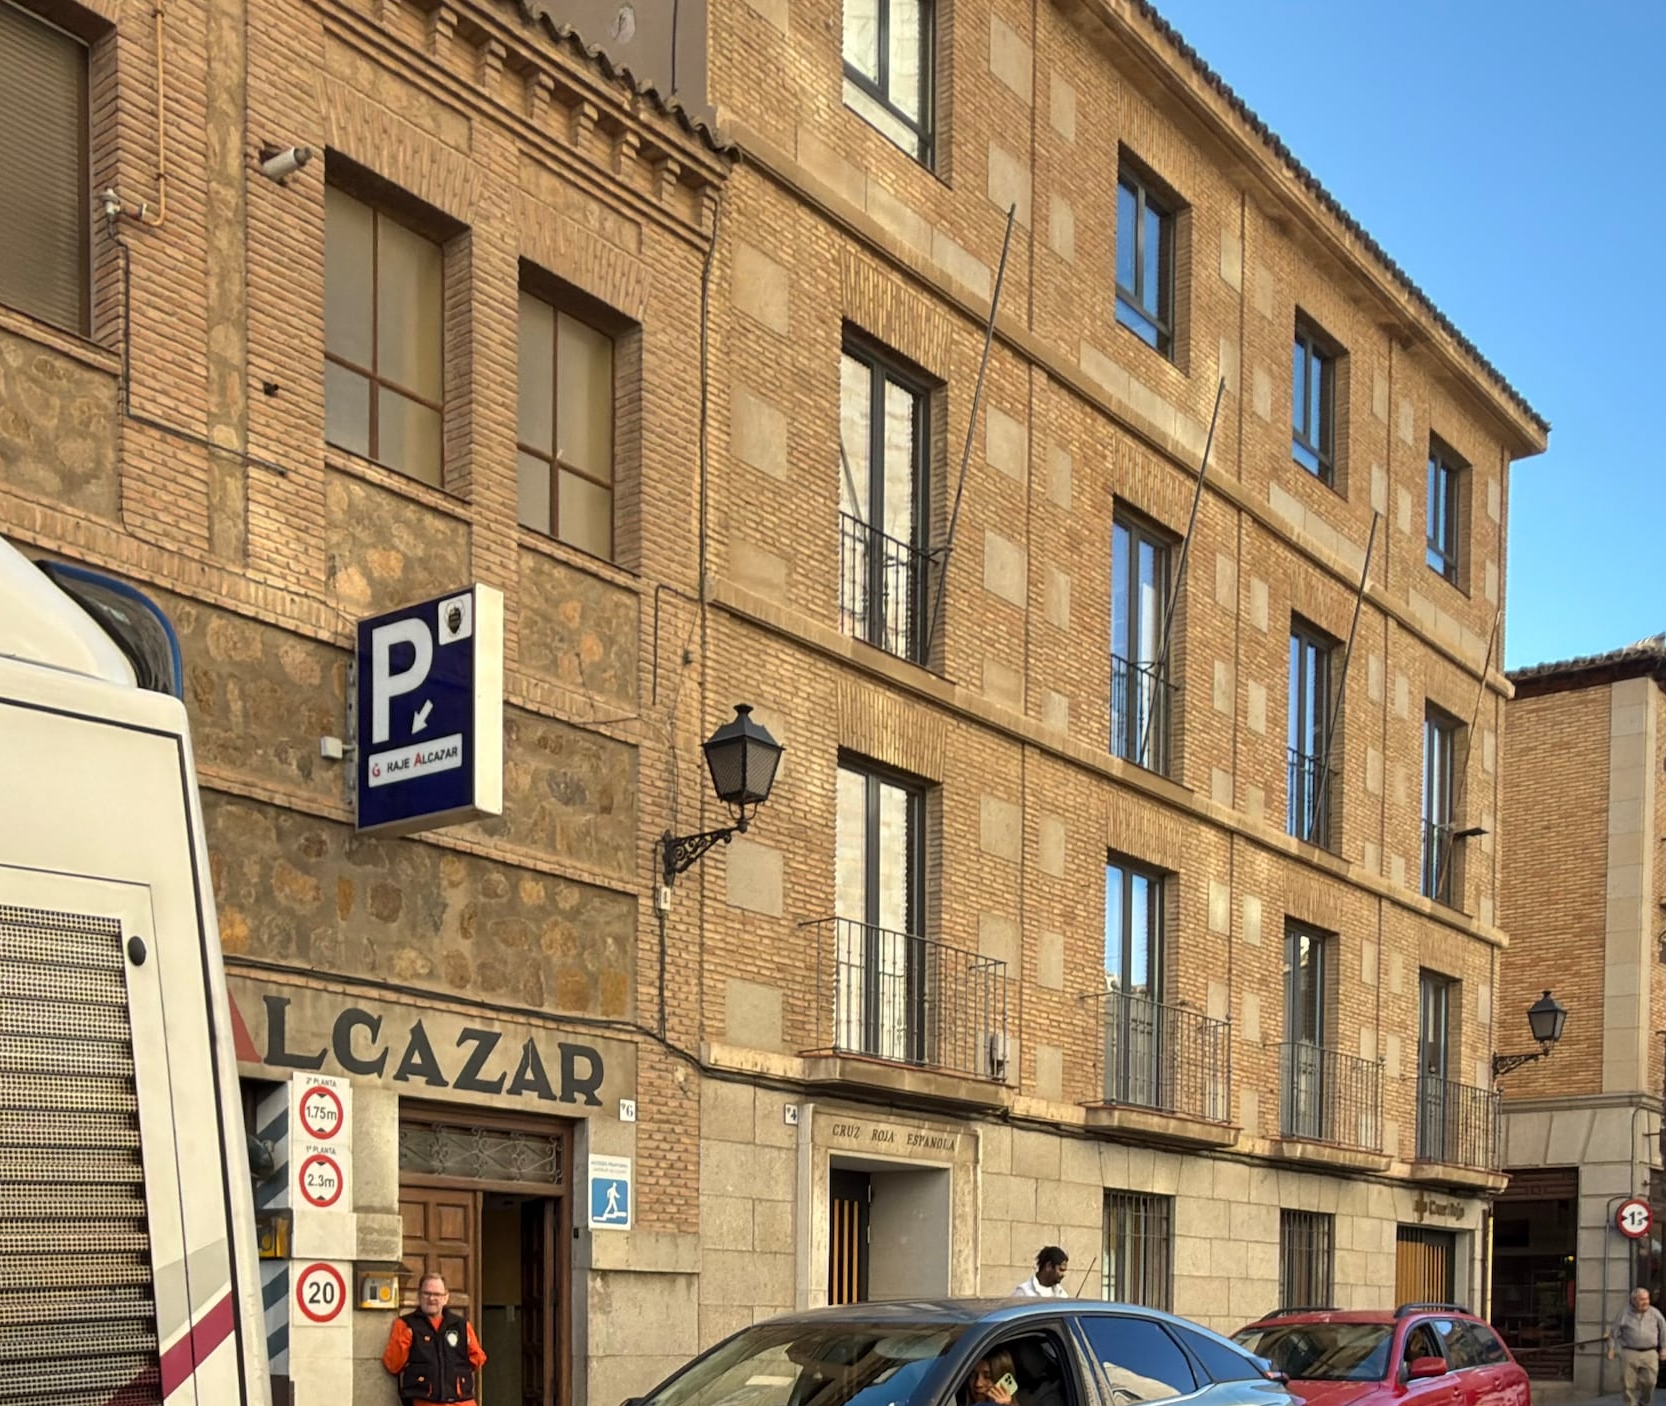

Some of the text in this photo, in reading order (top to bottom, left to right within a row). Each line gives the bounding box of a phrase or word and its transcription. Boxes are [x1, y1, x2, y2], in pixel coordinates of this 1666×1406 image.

[372, 617, 433, 744] P
[313, 1078, 337, 1087] PLANTA
[306, 1105, 337, 1120] 1.75m
[832, 1123, 861, 1139] CRUZ
[871, 1129, 894, 1143] ROJA
[313, 1145, 336, 1155] PLANTA
[307, 1173, 335, 1188] 2.3m
[308, 1281, 335, 1304] 20
